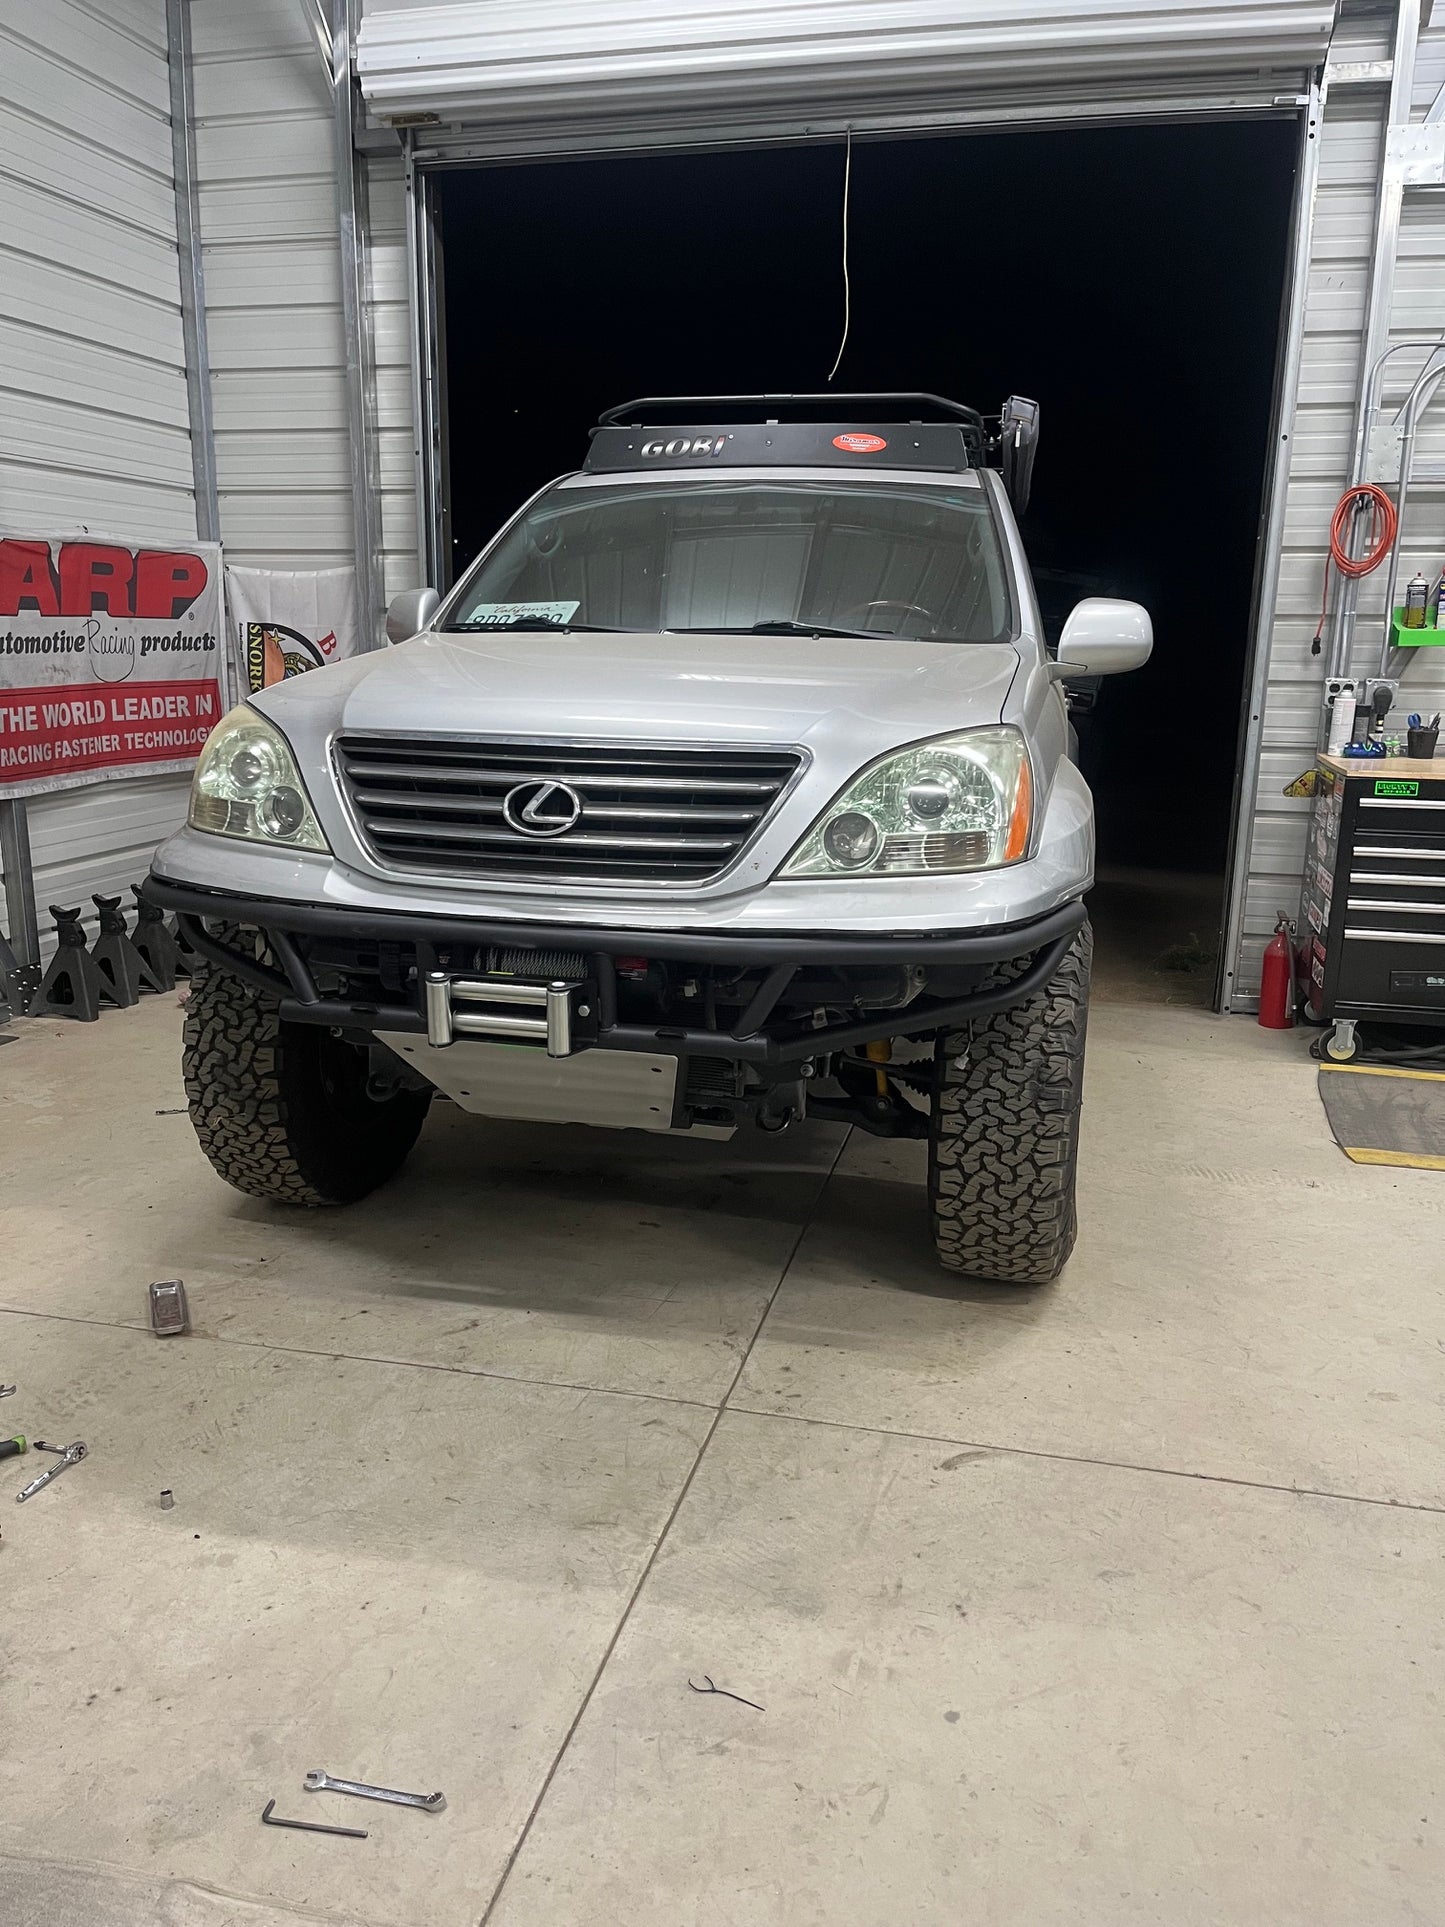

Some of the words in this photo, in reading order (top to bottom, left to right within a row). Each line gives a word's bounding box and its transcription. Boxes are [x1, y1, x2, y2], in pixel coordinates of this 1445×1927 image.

[641, 435, 726, 458] GOBI
[0, 538, 208, 619] ARP
[494, 605, 555, 615] California
[82, 619, 135, 683] Racing
[140, 631, 216, 656] products
[0, 706, 38, 733] THE
[42, 700, 106, 728] WORLD
[111, 696, 191, 721] LEADER
[195, 694, 213, 716] IN
[1, 743, 52, 767] RACING
[54, 734, 121, 759] FASTENER
